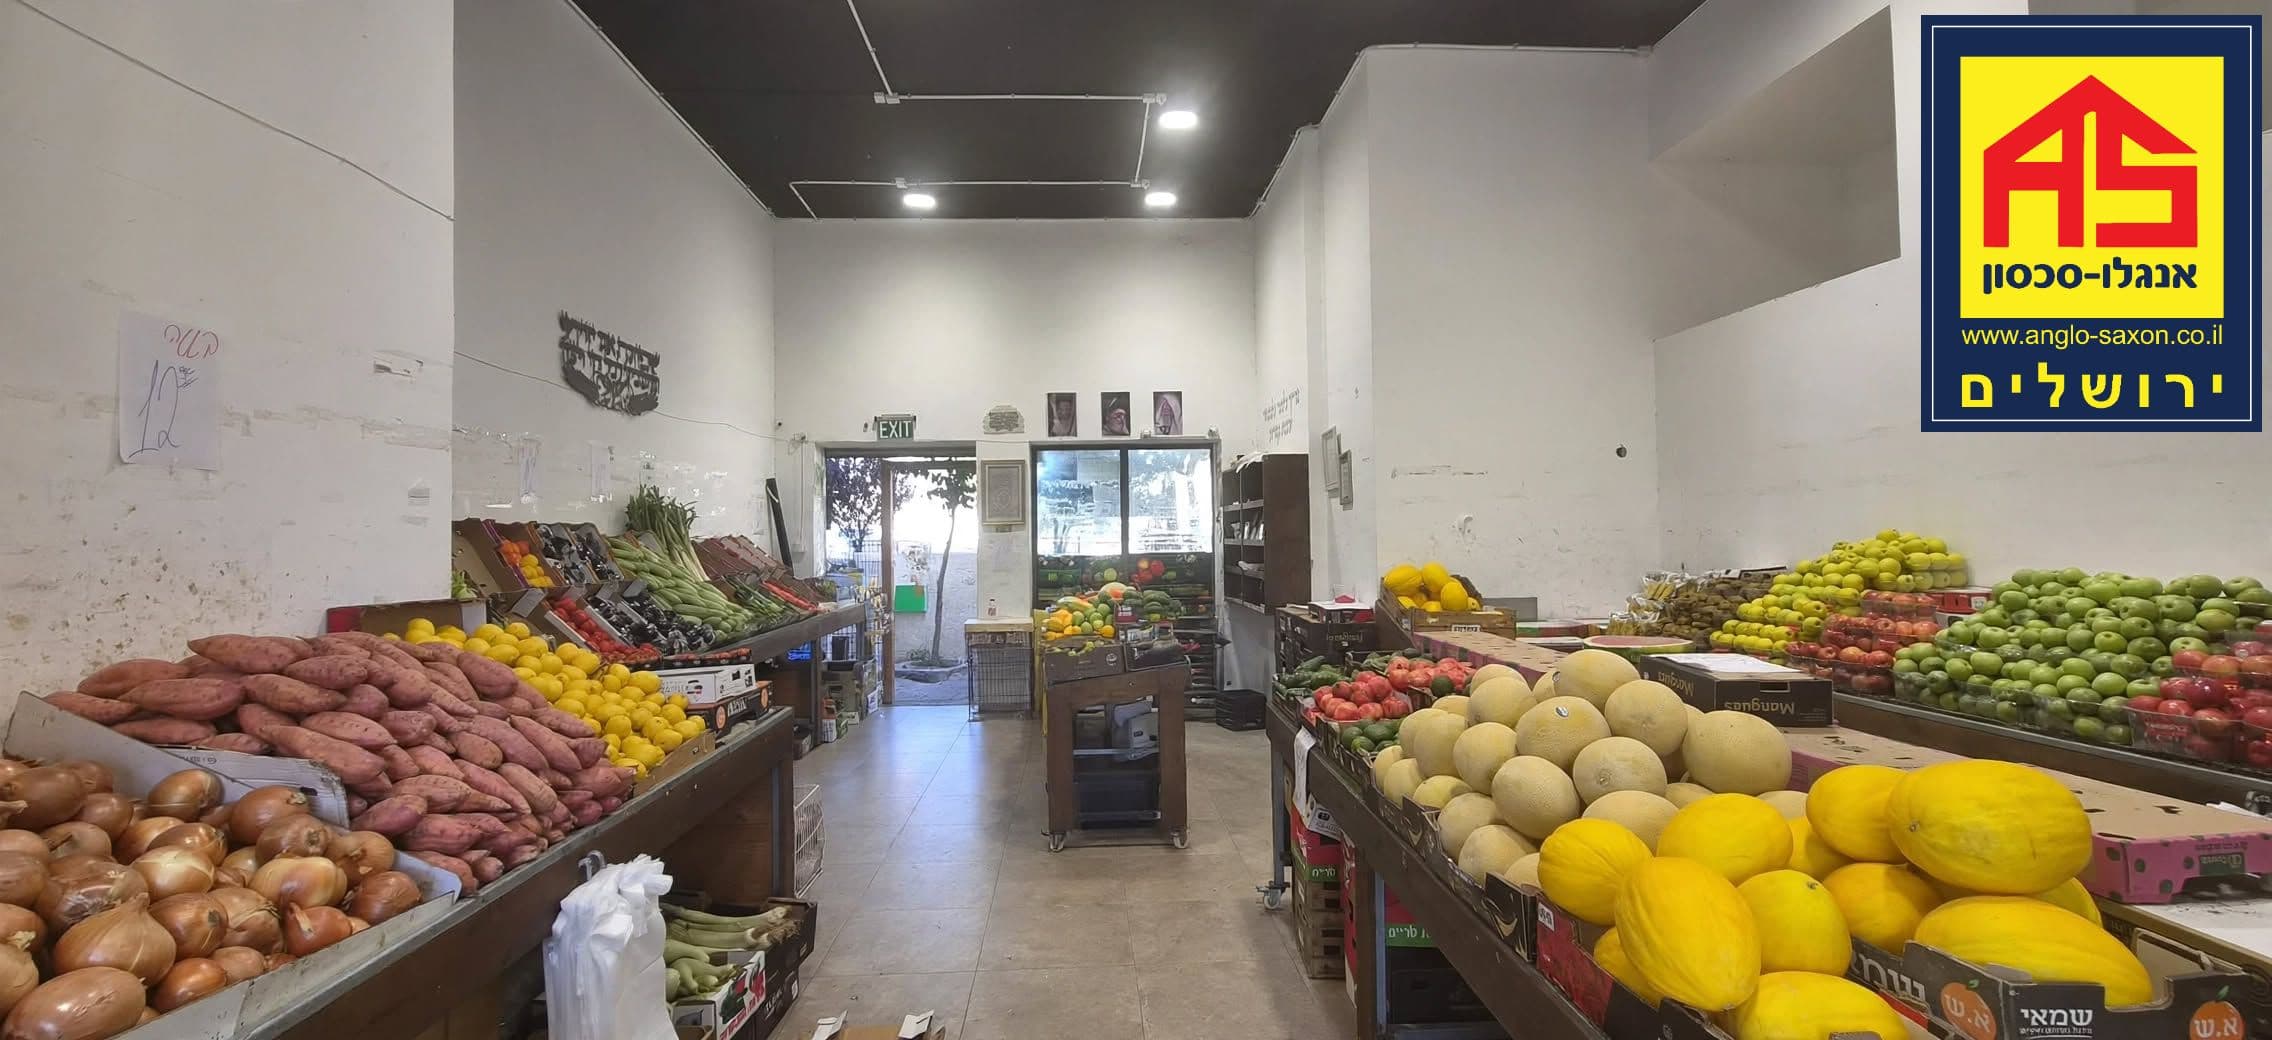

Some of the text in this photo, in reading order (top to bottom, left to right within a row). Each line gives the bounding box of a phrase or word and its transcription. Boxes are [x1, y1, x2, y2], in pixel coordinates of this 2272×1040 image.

[879, 420, 911, 439] EXIT
[2019, 1008, 2094, 1027] שמאי
[2194, 1017, 2239, 1039] א.ש
